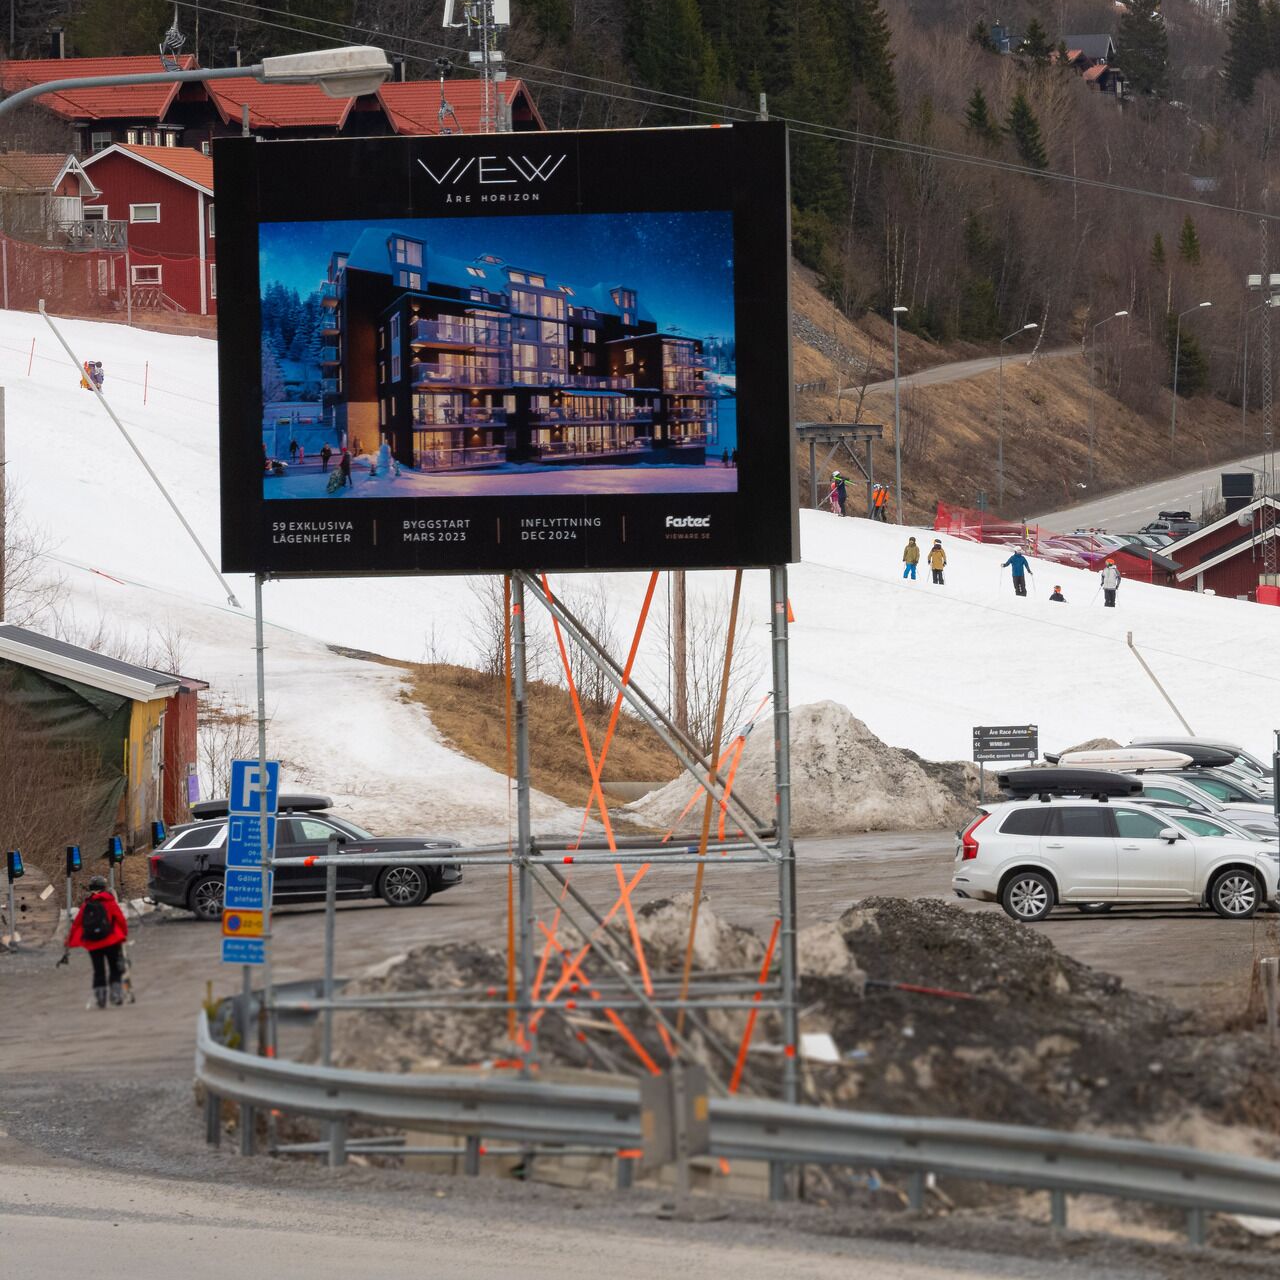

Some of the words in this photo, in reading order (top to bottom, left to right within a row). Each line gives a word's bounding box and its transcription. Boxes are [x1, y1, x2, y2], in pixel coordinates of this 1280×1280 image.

[416, 154, 567, 185] VIEW
[446, 194, 471, 203] ÅRE
[481, 193, 540, 202] HORIZON
[272, 522, 286, 531] 59
[289, 521, 353, 530] EXKLUSIVA
[403, 520, 470, 529] BYGGSTART
[521, 517, 601, 527] INFLYTTNING
[272, 533, 351, 543] LÄGENHETER
[403, 533, 435, 541] MARS
[438, 532, 466, 541] 2023
[521, 531, 545, 540] DEC
[548, 531, 577, 540] 2024
[242, 766, 270, 807] P
